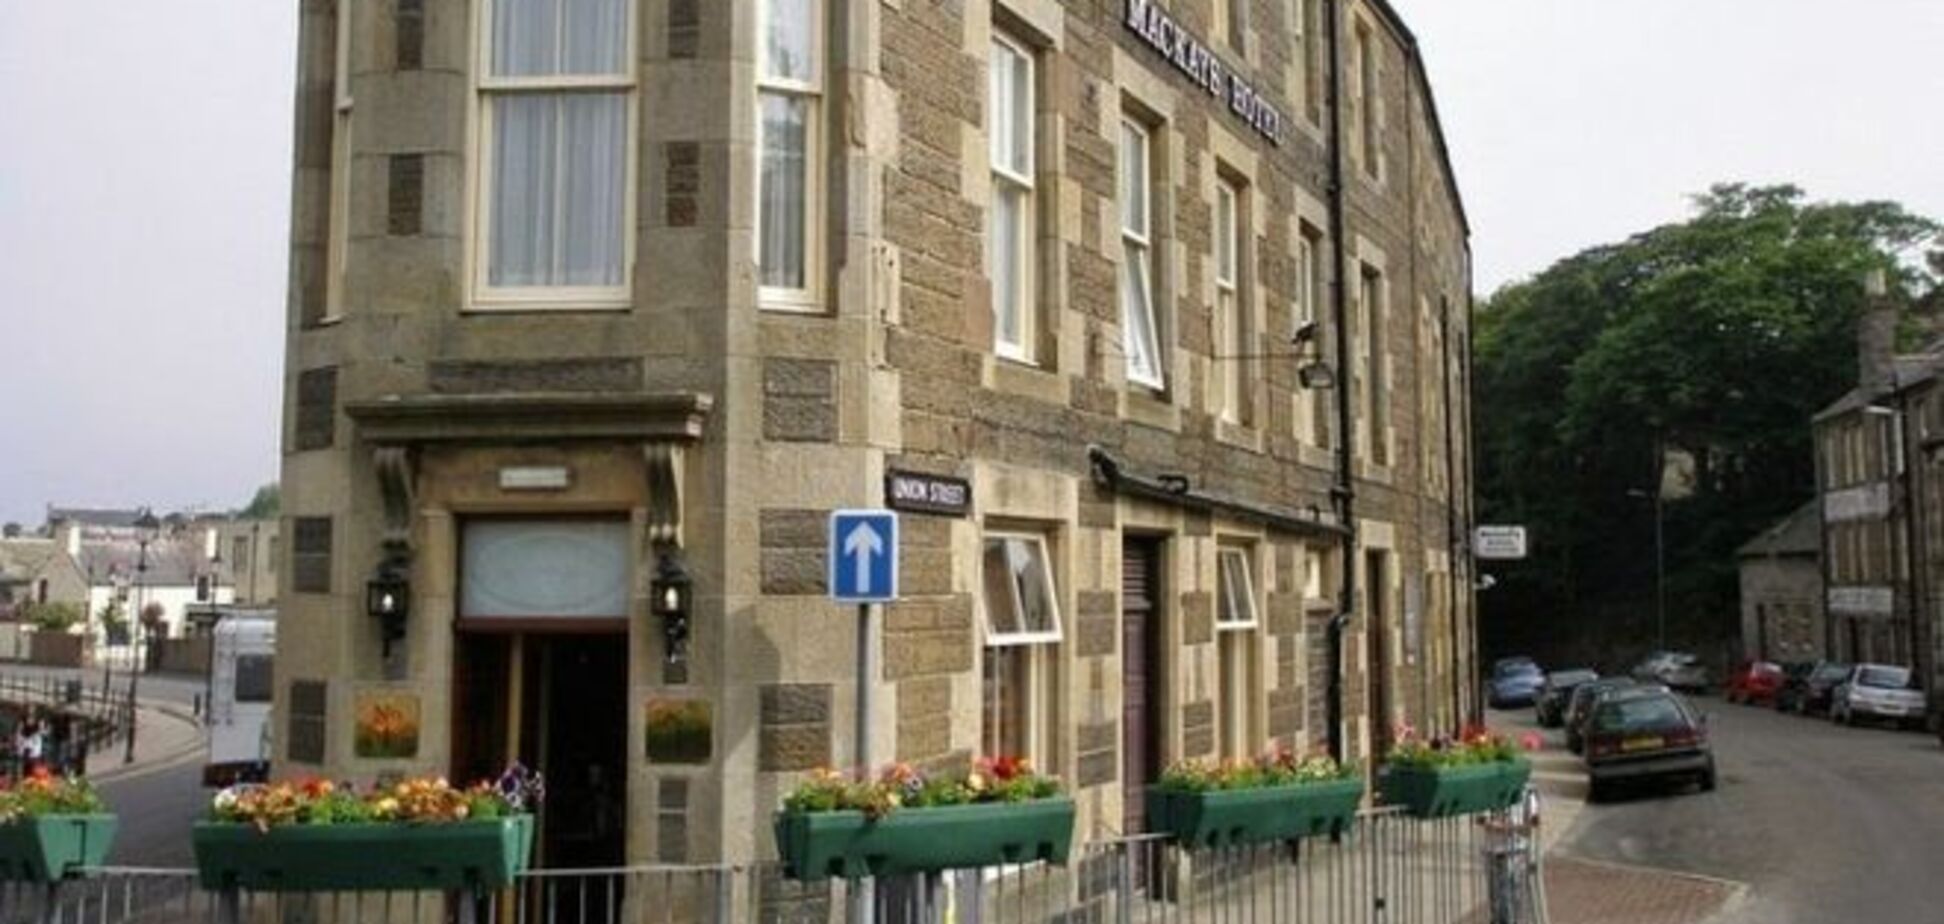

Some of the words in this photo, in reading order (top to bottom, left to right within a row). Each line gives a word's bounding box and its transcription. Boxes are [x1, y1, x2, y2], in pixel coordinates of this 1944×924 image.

[1232, 75, 1284, 145] HOTEL
[894, 476, 927, 501] UNION
[929, 481, 965, 506] STREET
